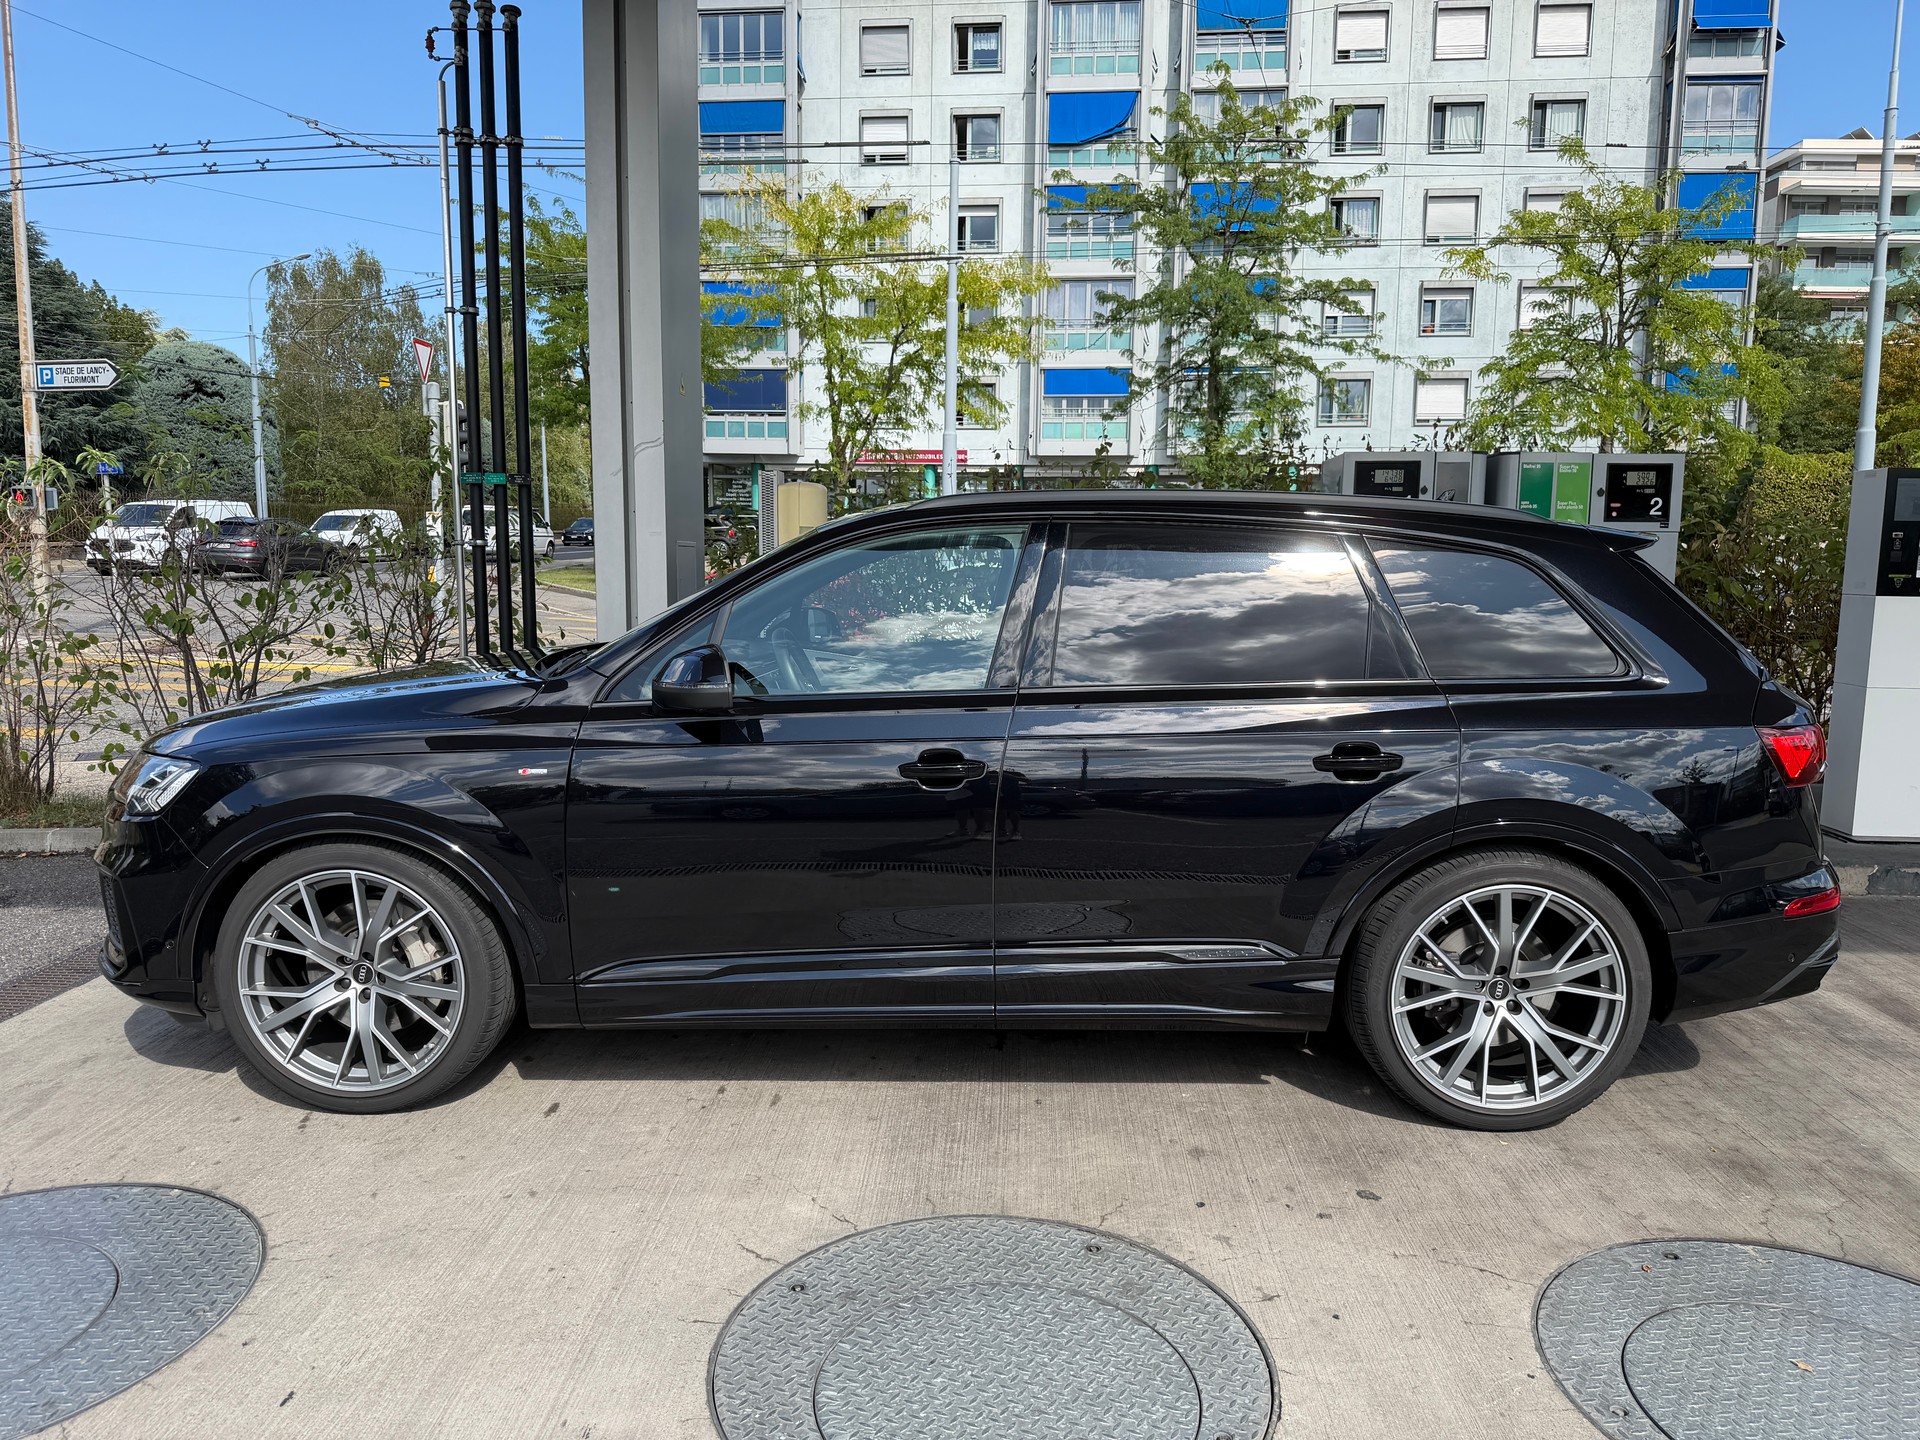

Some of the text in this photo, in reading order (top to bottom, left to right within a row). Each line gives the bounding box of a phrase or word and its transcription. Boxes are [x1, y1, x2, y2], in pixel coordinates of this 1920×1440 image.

[55, 367, 75, 375] STADE
[86, 366, 110, 374] LANCY-
[63, 375, 100, 384] FLORIMONT
[1649, 497, 1663, 515] 2
